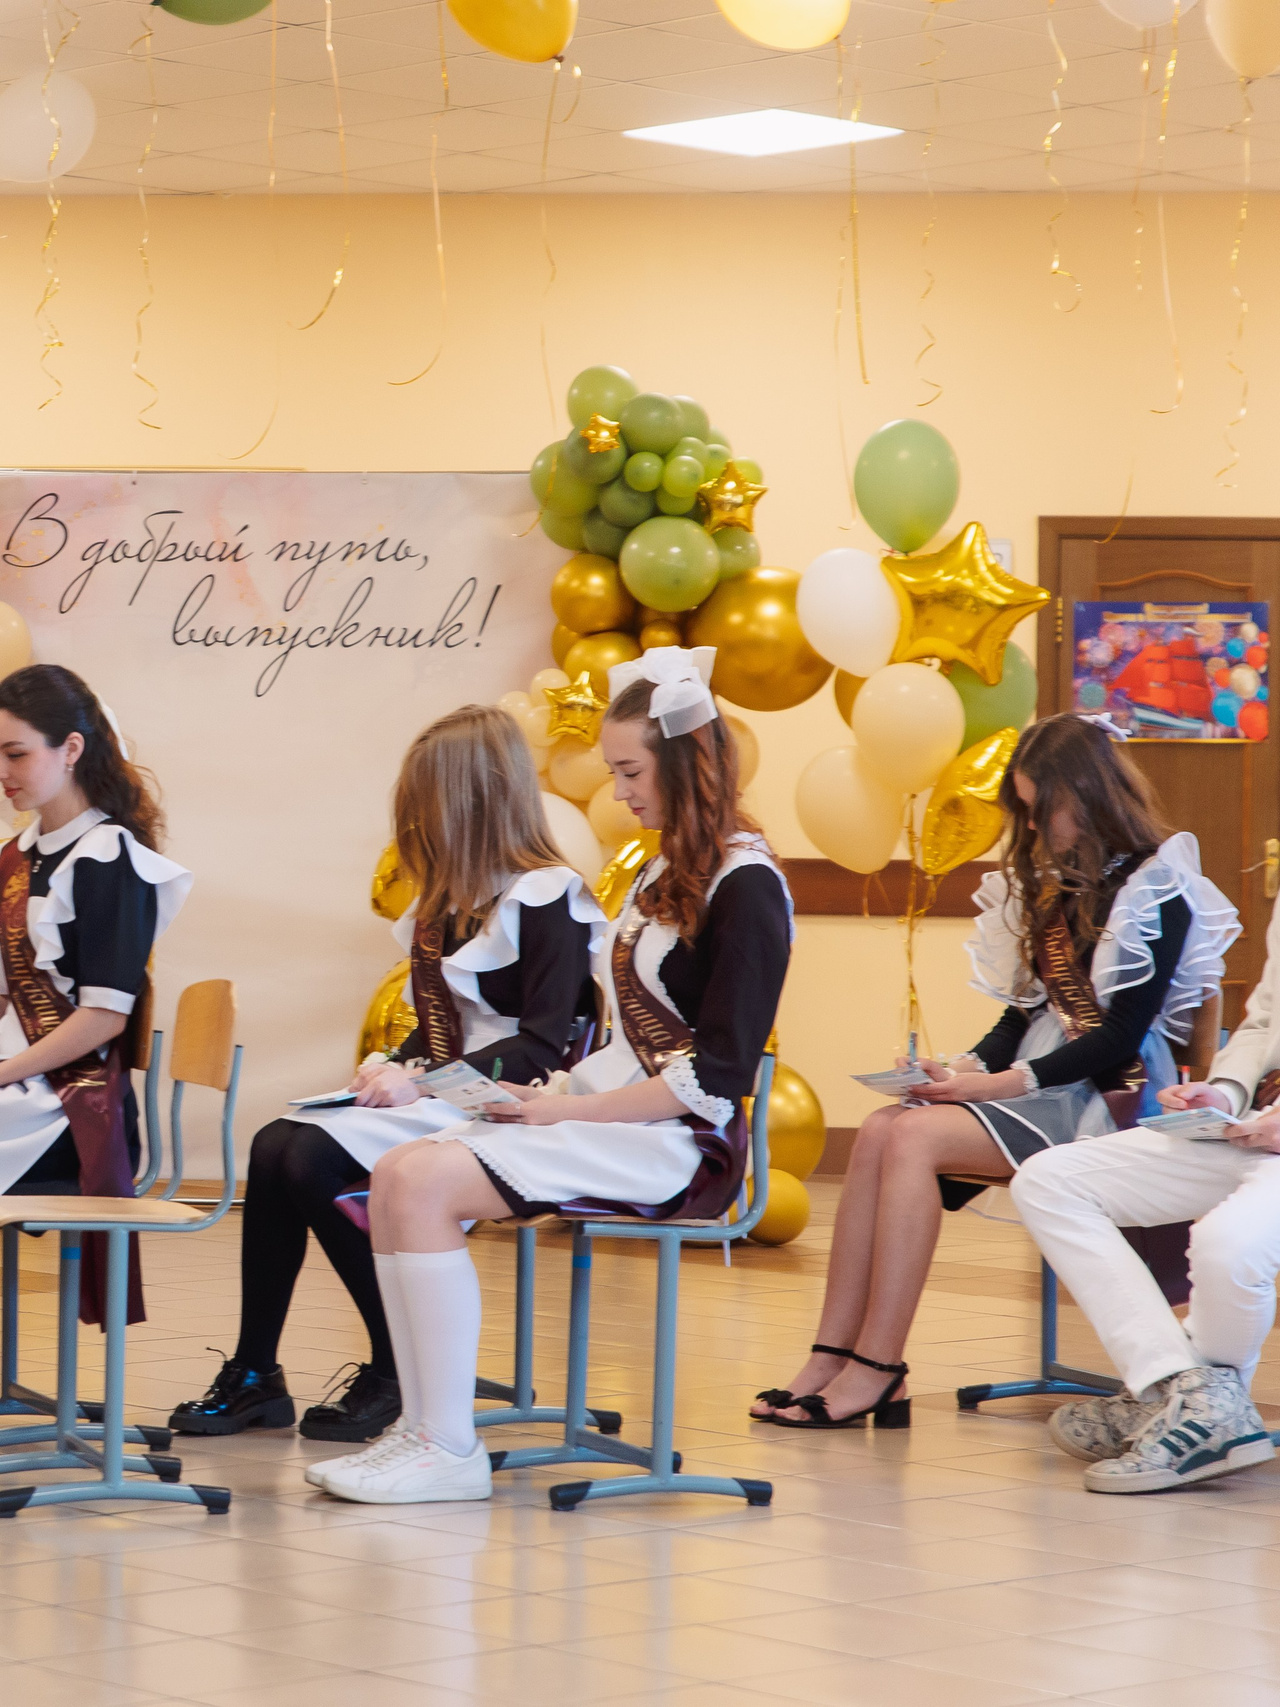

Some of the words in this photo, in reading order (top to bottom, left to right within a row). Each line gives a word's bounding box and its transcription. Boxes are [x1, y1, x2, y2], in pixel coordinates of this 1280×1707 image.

[1, 492, 69, 569] В
[58, 509, 254, 615] добрый
[264, 536, 430, 613] путь,
[171, 573, 503, 698] выпускник!
